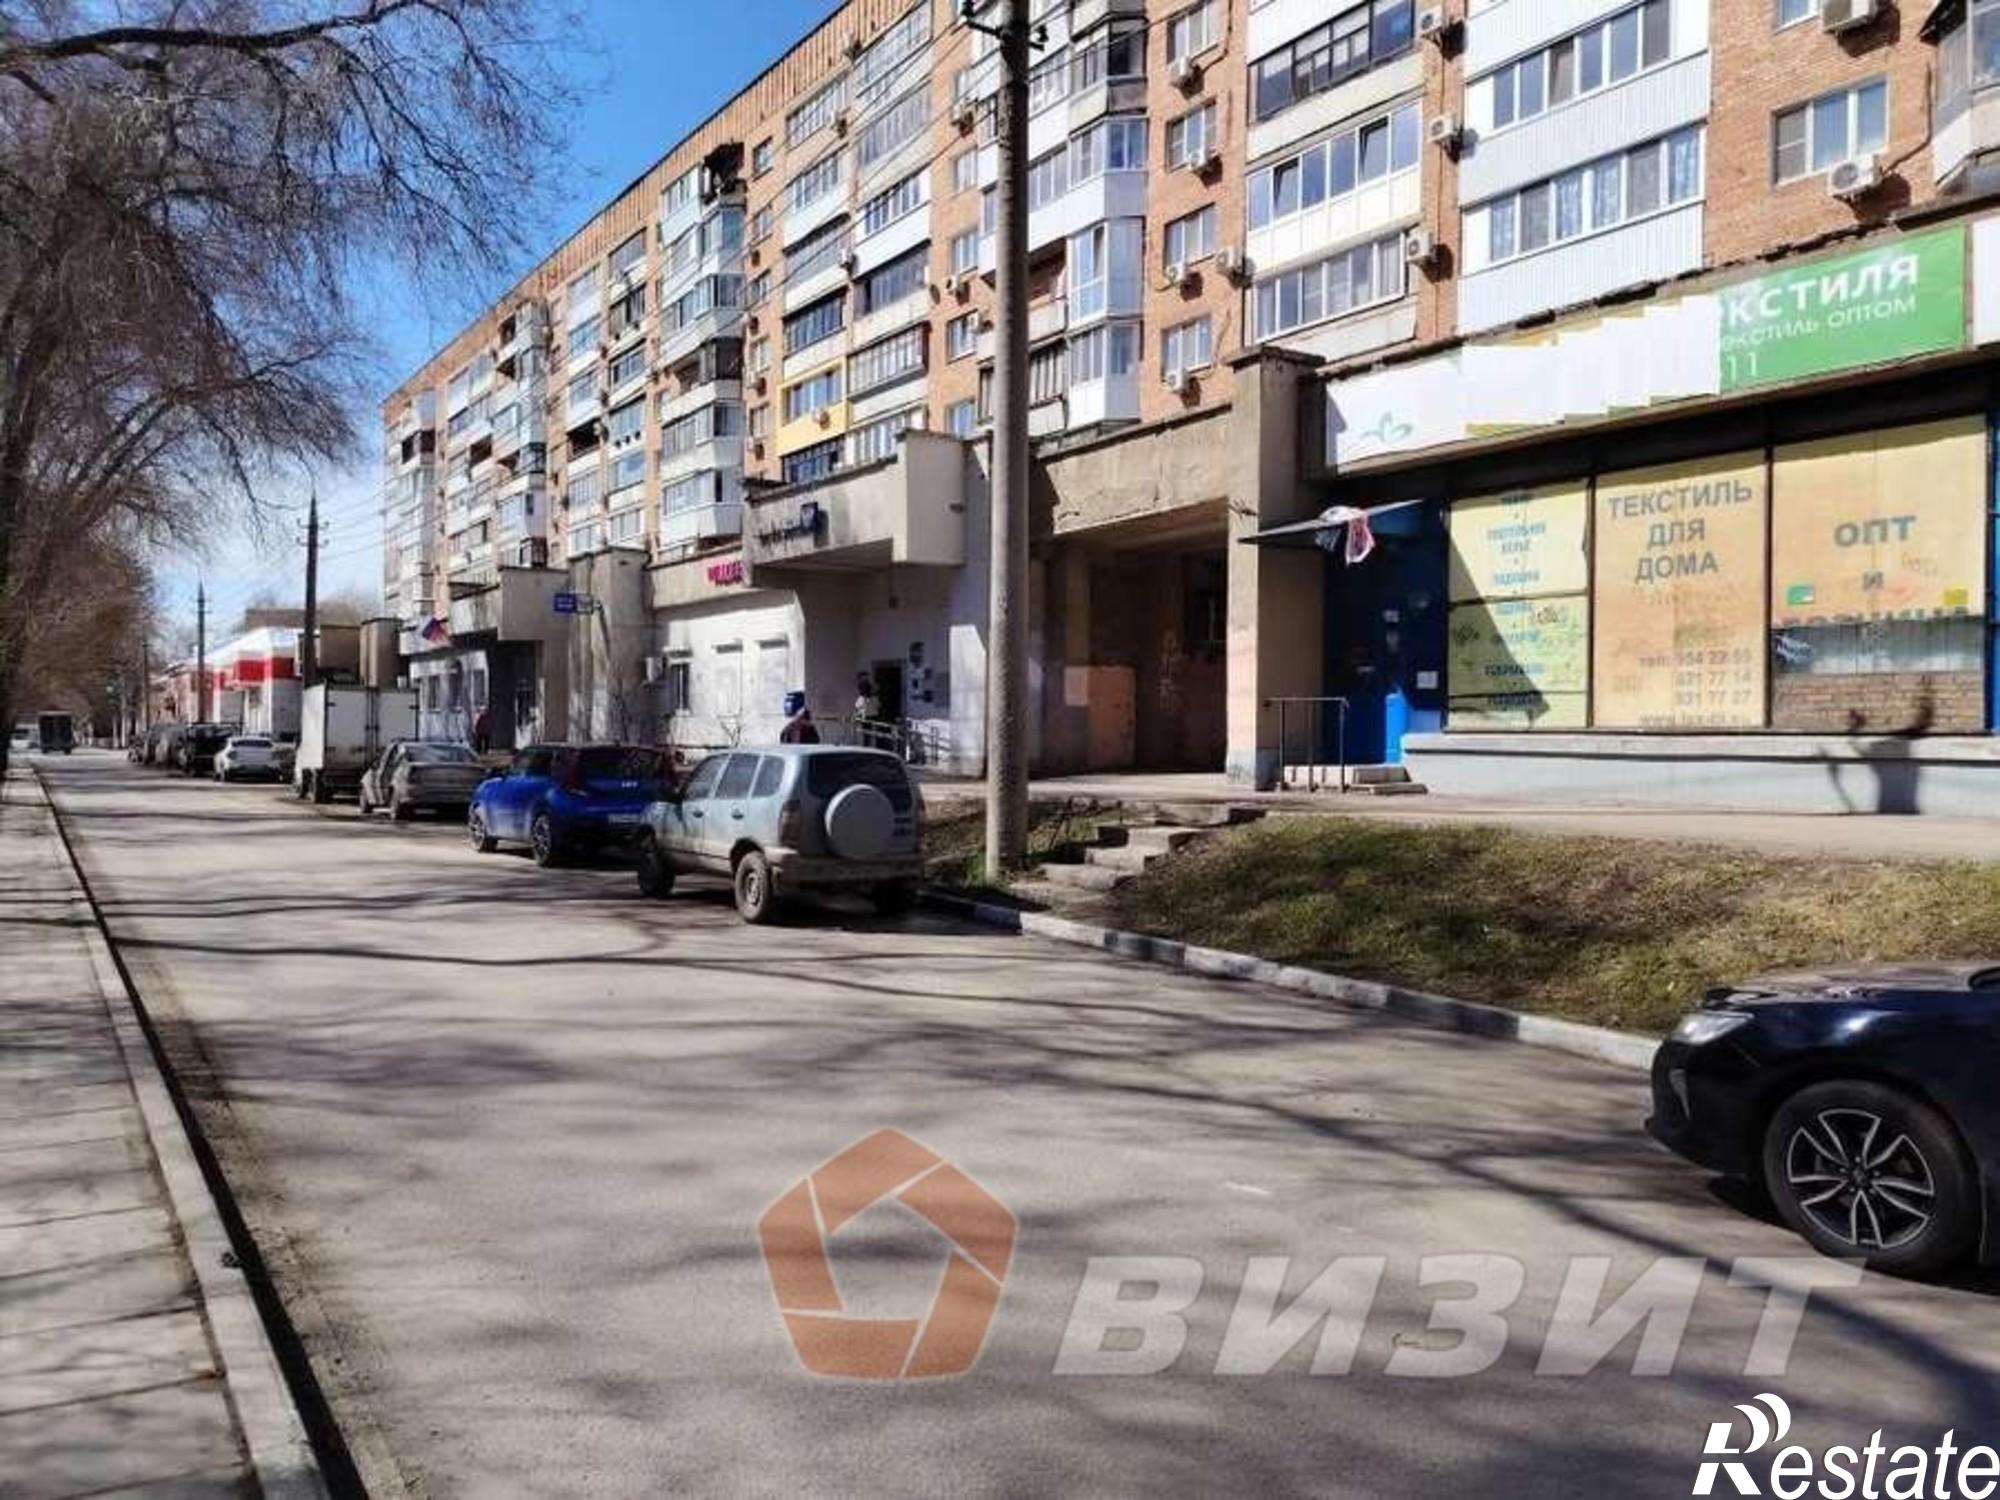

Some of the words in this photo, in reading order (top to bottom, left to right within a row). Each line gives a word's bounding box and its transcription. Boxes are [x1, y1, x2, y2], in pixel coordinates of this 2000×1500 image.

[1716, 253, 1919, 328] КСТИЛЯ
[1608, 479, 1753, 519] ТЕКСТИЛЬ
[1648, 517, 1706, 549] ДЛЯ
[1833, 514, 1917, 548] ОПТ
[1635, 551, 1719, 585] ДОМА
